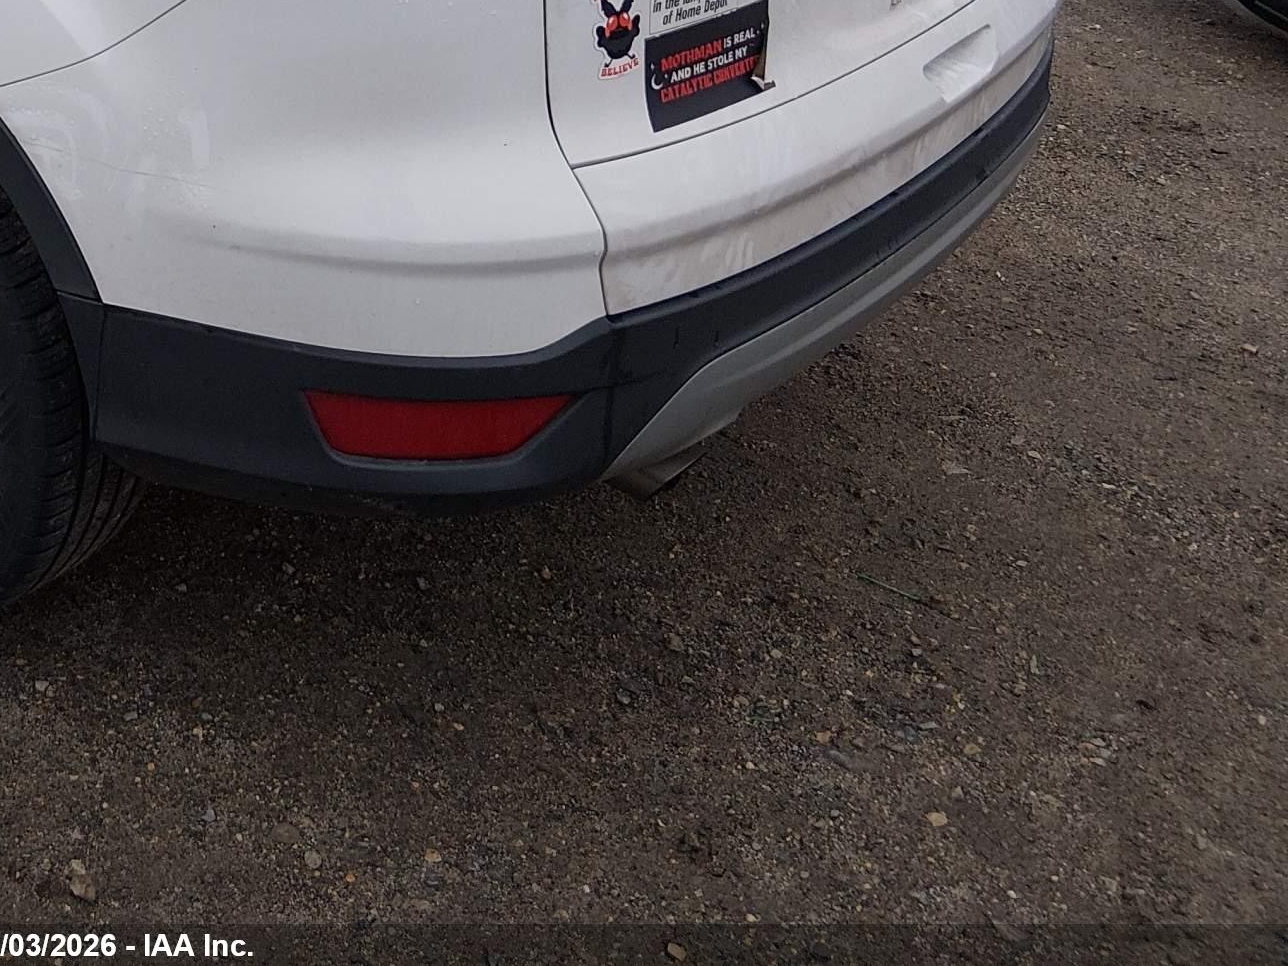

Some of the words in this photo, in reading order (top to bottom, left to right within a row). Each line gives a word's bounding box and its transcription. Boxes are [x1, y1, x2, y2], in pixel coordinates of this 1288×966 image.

[652, 0, 662, 13] in
[662, 10, 673, 25] of
[675, 5, 701, 22] Home
[660, 39, 724, 71] MOTHMAN
[723, 35, 732, 48] IS
[733, 27, 756, 44] REAL
[601, 58, 639, 77] BELIEVE
[670, 66, 692, 82] AND
[693, 60, 706, 76] HE
[707, 50, 733, 70] STOLE
[735, 45, 749, 61] MY
[660, 73, 713, 104] CATALYTIC
